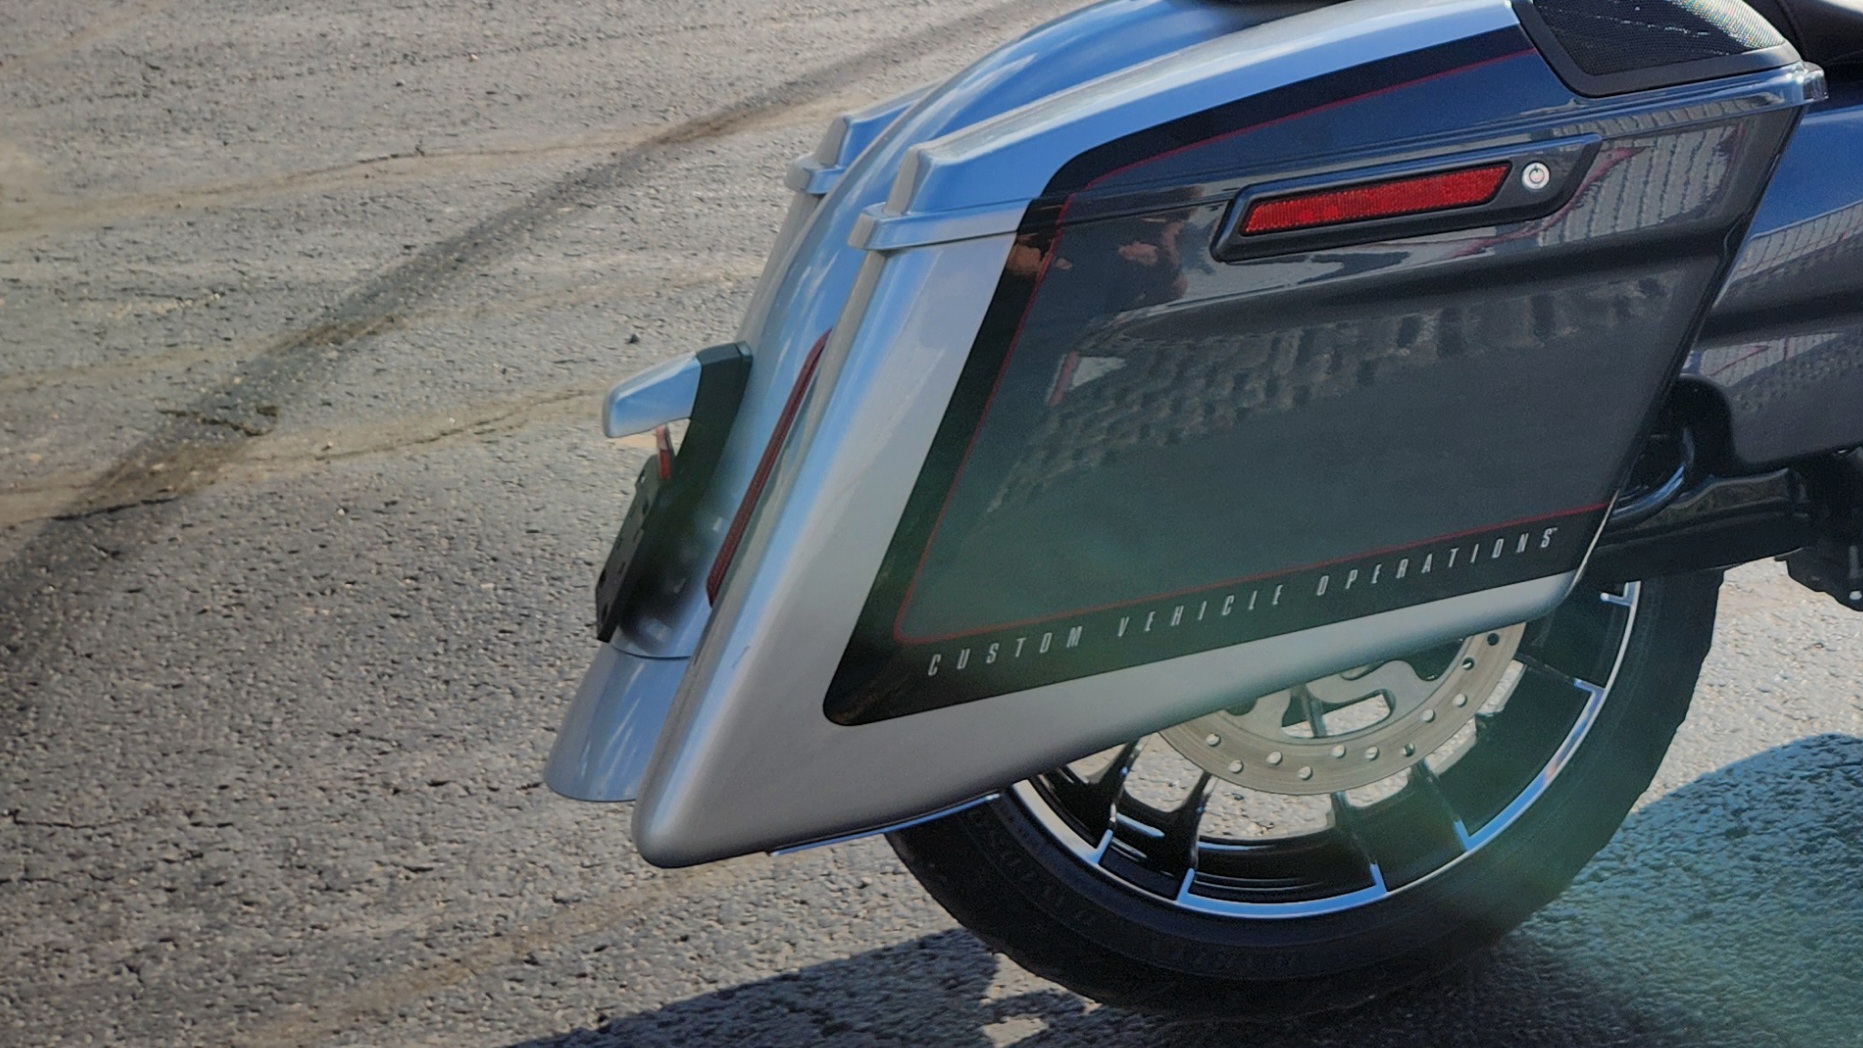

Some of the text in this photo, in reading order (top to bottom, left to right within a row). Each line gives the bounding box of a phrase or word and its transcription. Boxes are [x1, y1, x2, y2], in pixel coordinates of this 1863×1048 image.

[928, 527, 1557, 676] CUSTOM VEHICLE OPERATIONS
